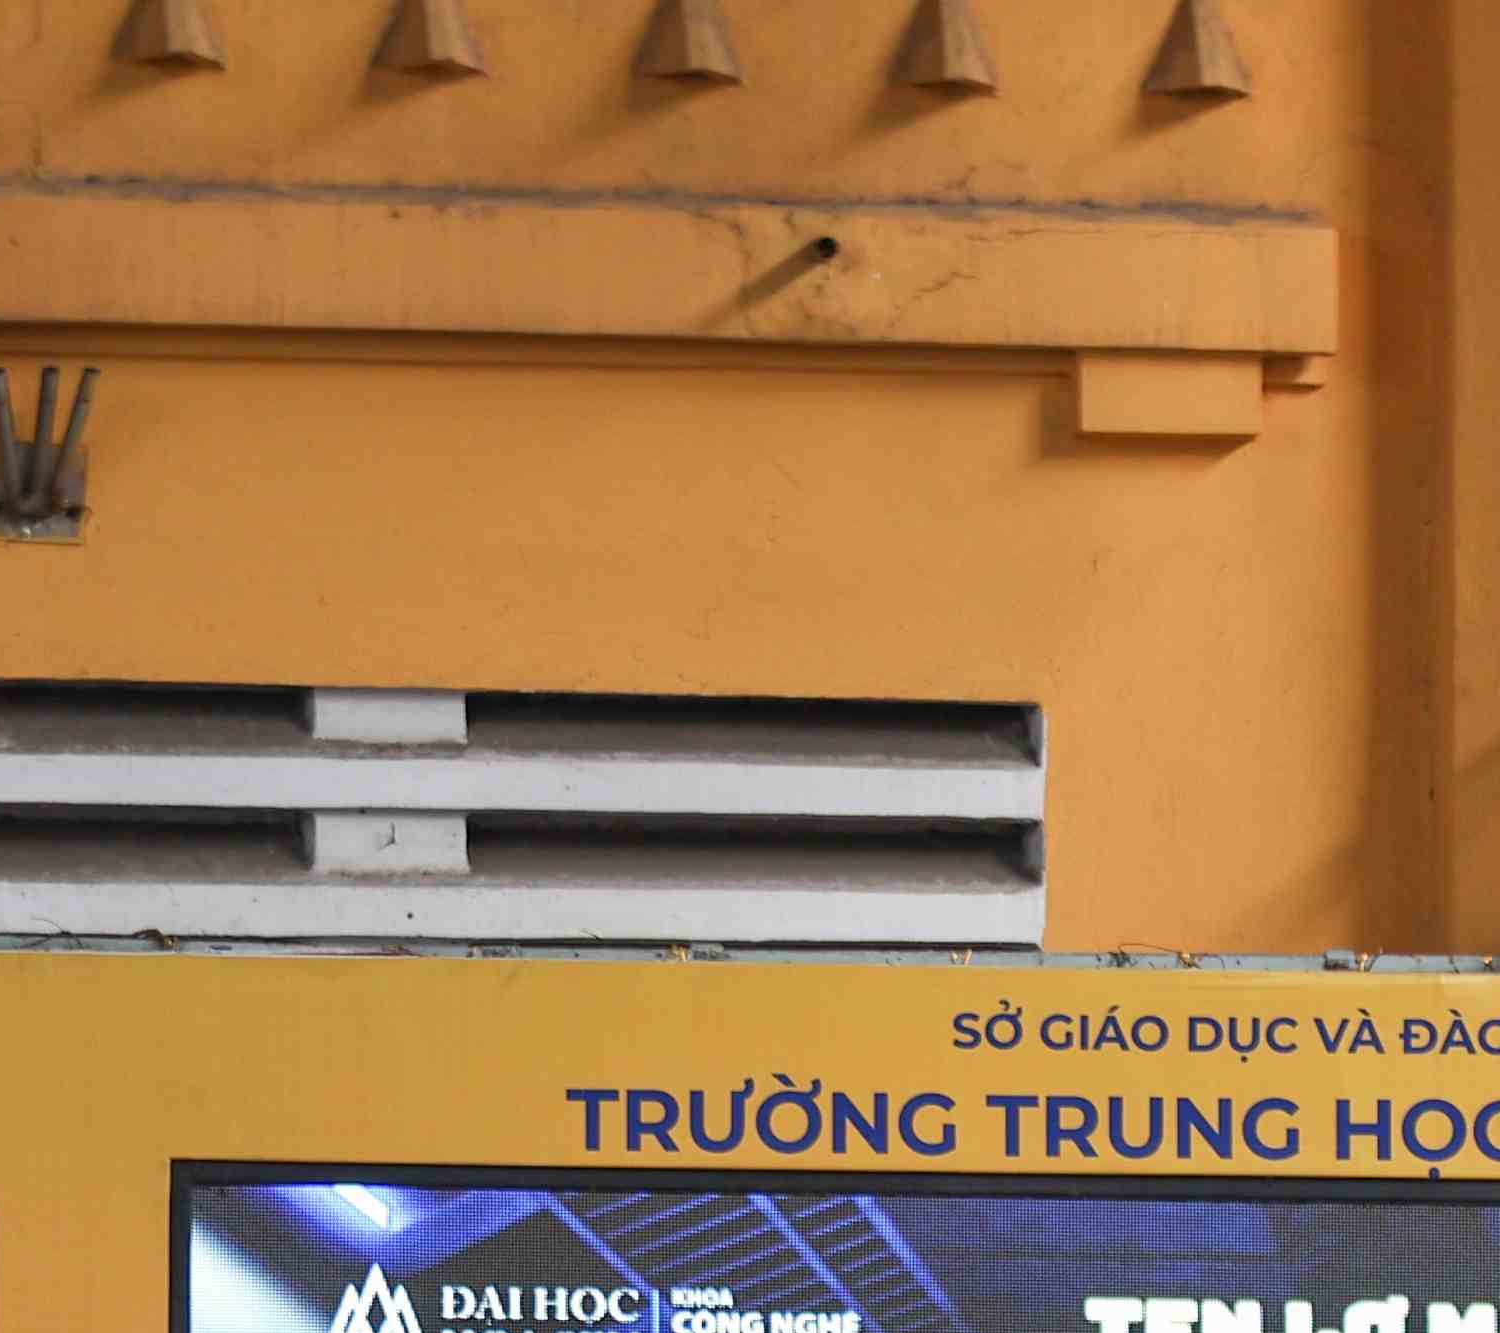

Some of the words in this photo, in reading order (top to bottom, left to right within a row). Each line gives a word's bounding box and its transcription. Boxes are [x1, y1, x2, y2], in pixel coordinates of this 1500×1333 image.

[952, 1006, 1024, 1050] SỞ
[1040, 1008, 1169, 1052] GIÁO
[1187, 1016, 1297, 1062] DỤC
[1314, 1008, 1384, 1054] VÀ
[566, 1073, 957, 1156] TRƯỜNG
[985, 1095, 1301, 1159] TRUNG
[440, 1285, 523, 1327] ĐẠI
[534, 1286, 642, 1324] HỌC
